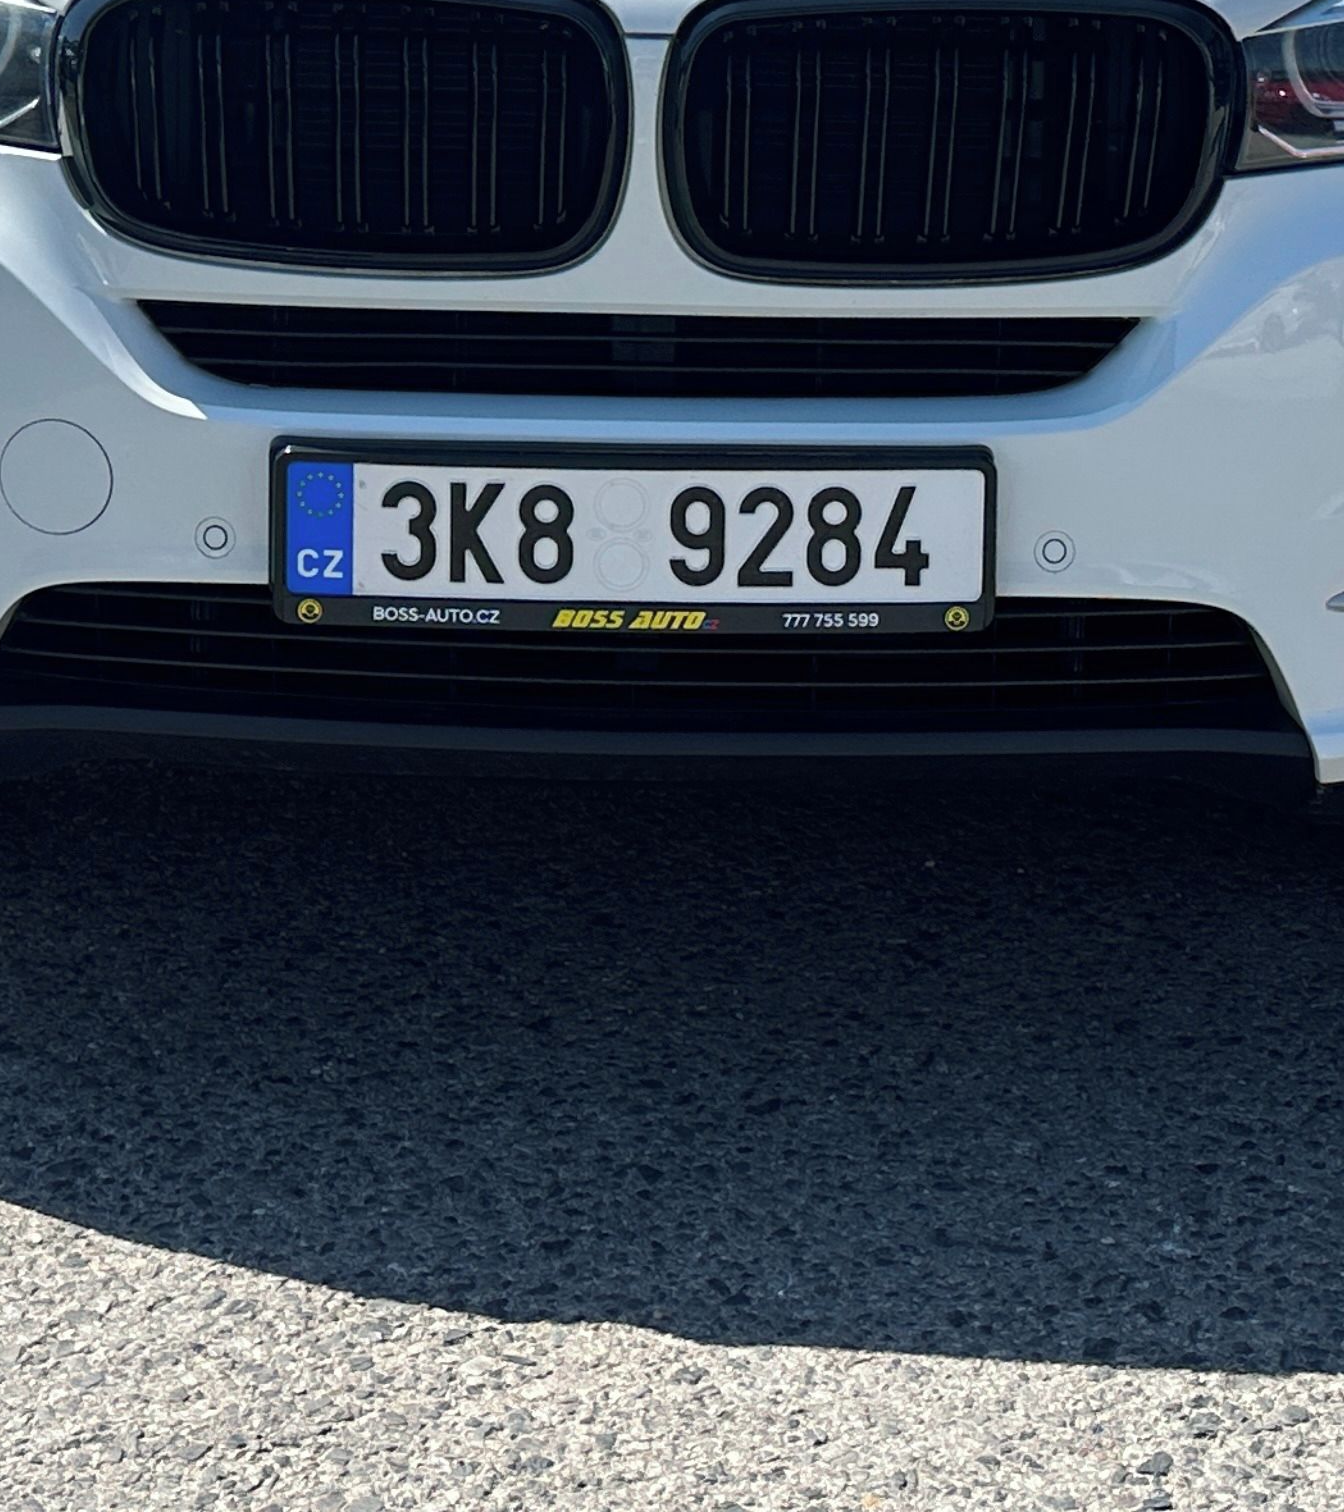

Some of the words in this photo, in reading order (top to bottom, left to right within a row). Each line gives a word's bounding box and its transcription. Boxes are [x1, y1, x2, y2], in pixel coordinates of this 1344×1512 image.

[380, 481, 575, 585] 3K8
[669, 485, 930, 587] 9284
[296, 548, 344, 579] CZ
[372, 606, 500, 625] BOSS-AUTO.CZ
[552, 609, 624, 630] BOSS
[627, 610, 706, 631] AUTO
[782, 613, 812, 629] 777
[814, 613, 844, 629] 755
[847, 613, 879, 629] 599
